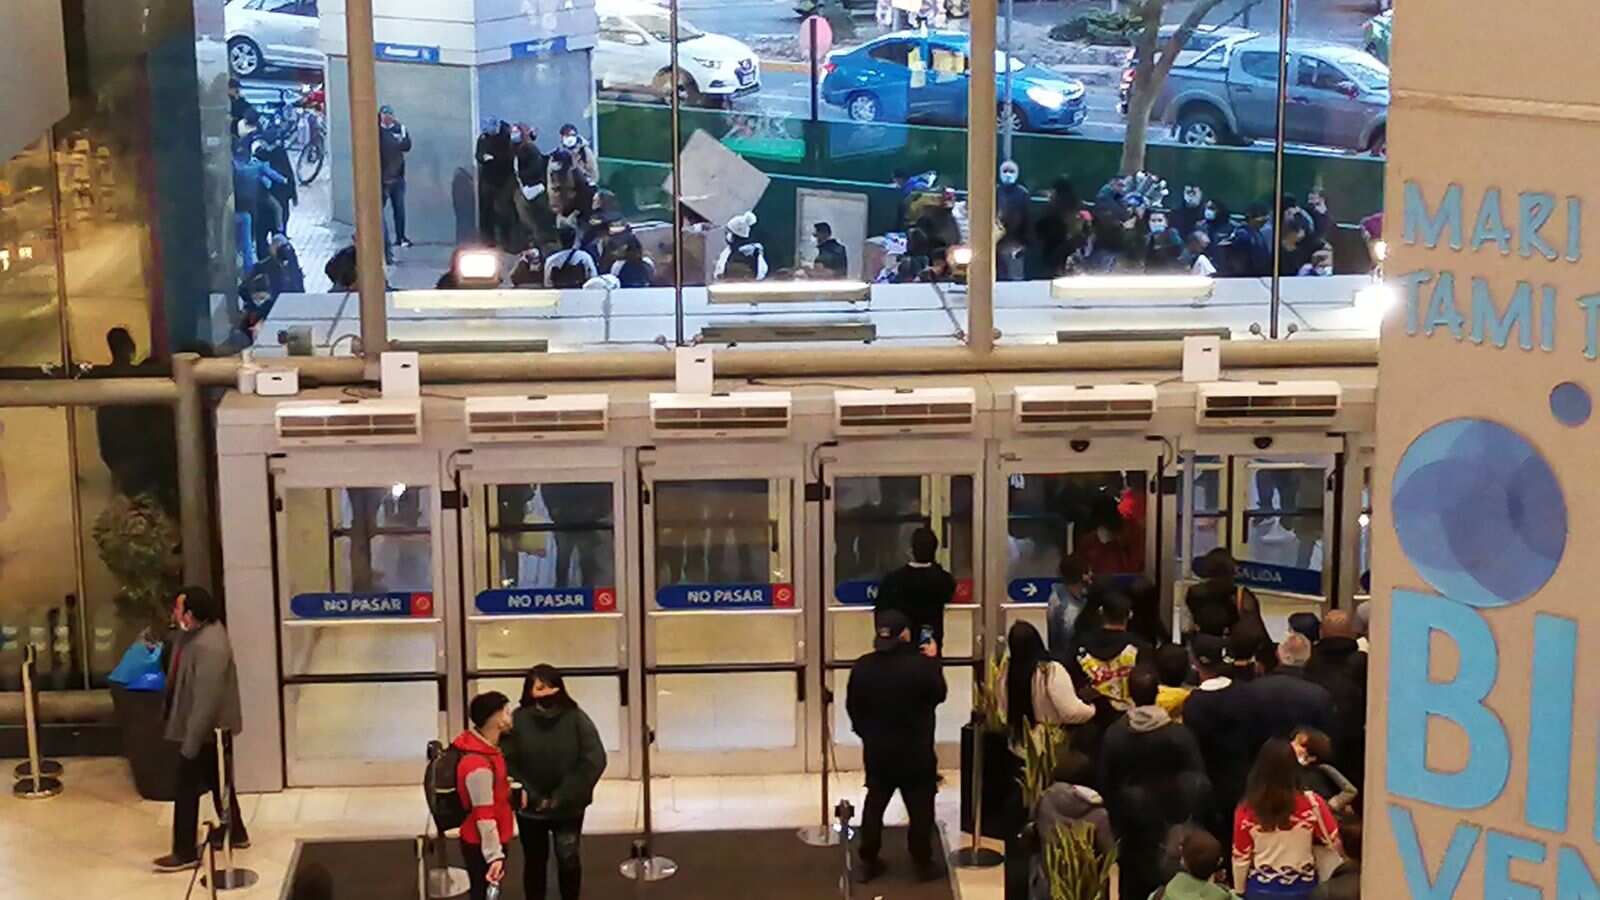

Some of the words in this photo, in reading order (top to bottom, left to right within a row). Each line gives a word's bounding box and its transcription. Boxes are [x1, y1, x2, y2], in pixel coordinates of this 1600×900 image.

[1402, 180, 1582, 263] MARI
[1399, 269, 1557, 351] TAMI
[323, 598, 348, 612] NO
[349, 597, 402, 612] PASAR
[507, 594, 531, 608] NO
[534, 593, 584, 608] PASAR
[687, 590, 711, 604] NO
[713, 589, 764, 602] PASAR
[1386, 586, 1600, 843] BI
